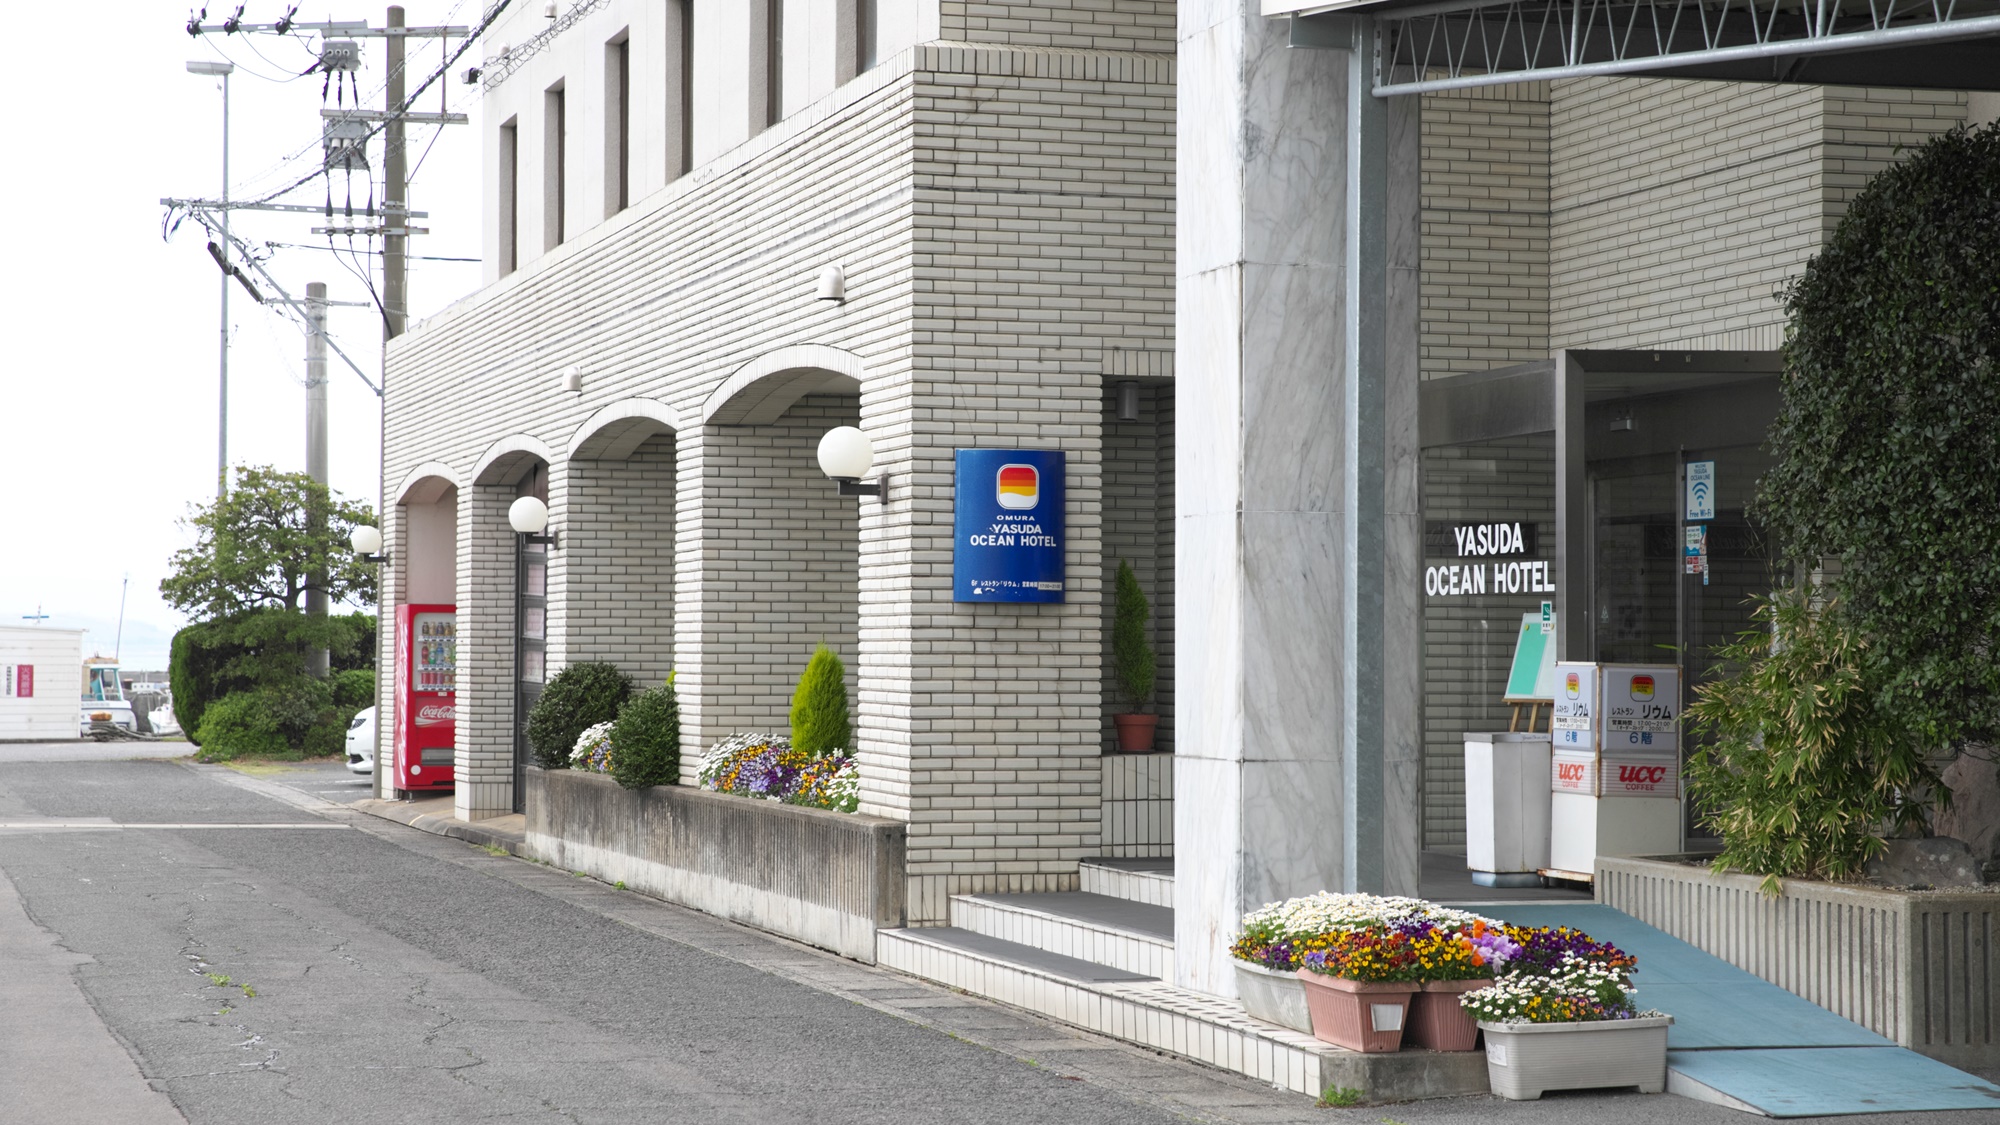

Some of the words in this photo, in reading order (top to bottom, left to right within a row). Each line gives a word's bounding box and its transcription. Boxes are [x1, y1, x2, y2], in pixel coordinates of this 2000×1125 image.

[992, 524, 1042, 534] YASUDA
[970, 535, 1014, 546] OCEAN
[1021, 536, 1056, 547] HOTEL
[1454, 522, 1524, 556] YASUDA
[1426, 564, 1485, 596] OCEAN
[1494, 561, 1555, 594] HOTEL
[1573, 703, 1588, 717] リウム
[1612, 708, 1634, 716] レストラン
[1642, 704, 1671, 719] リウム
